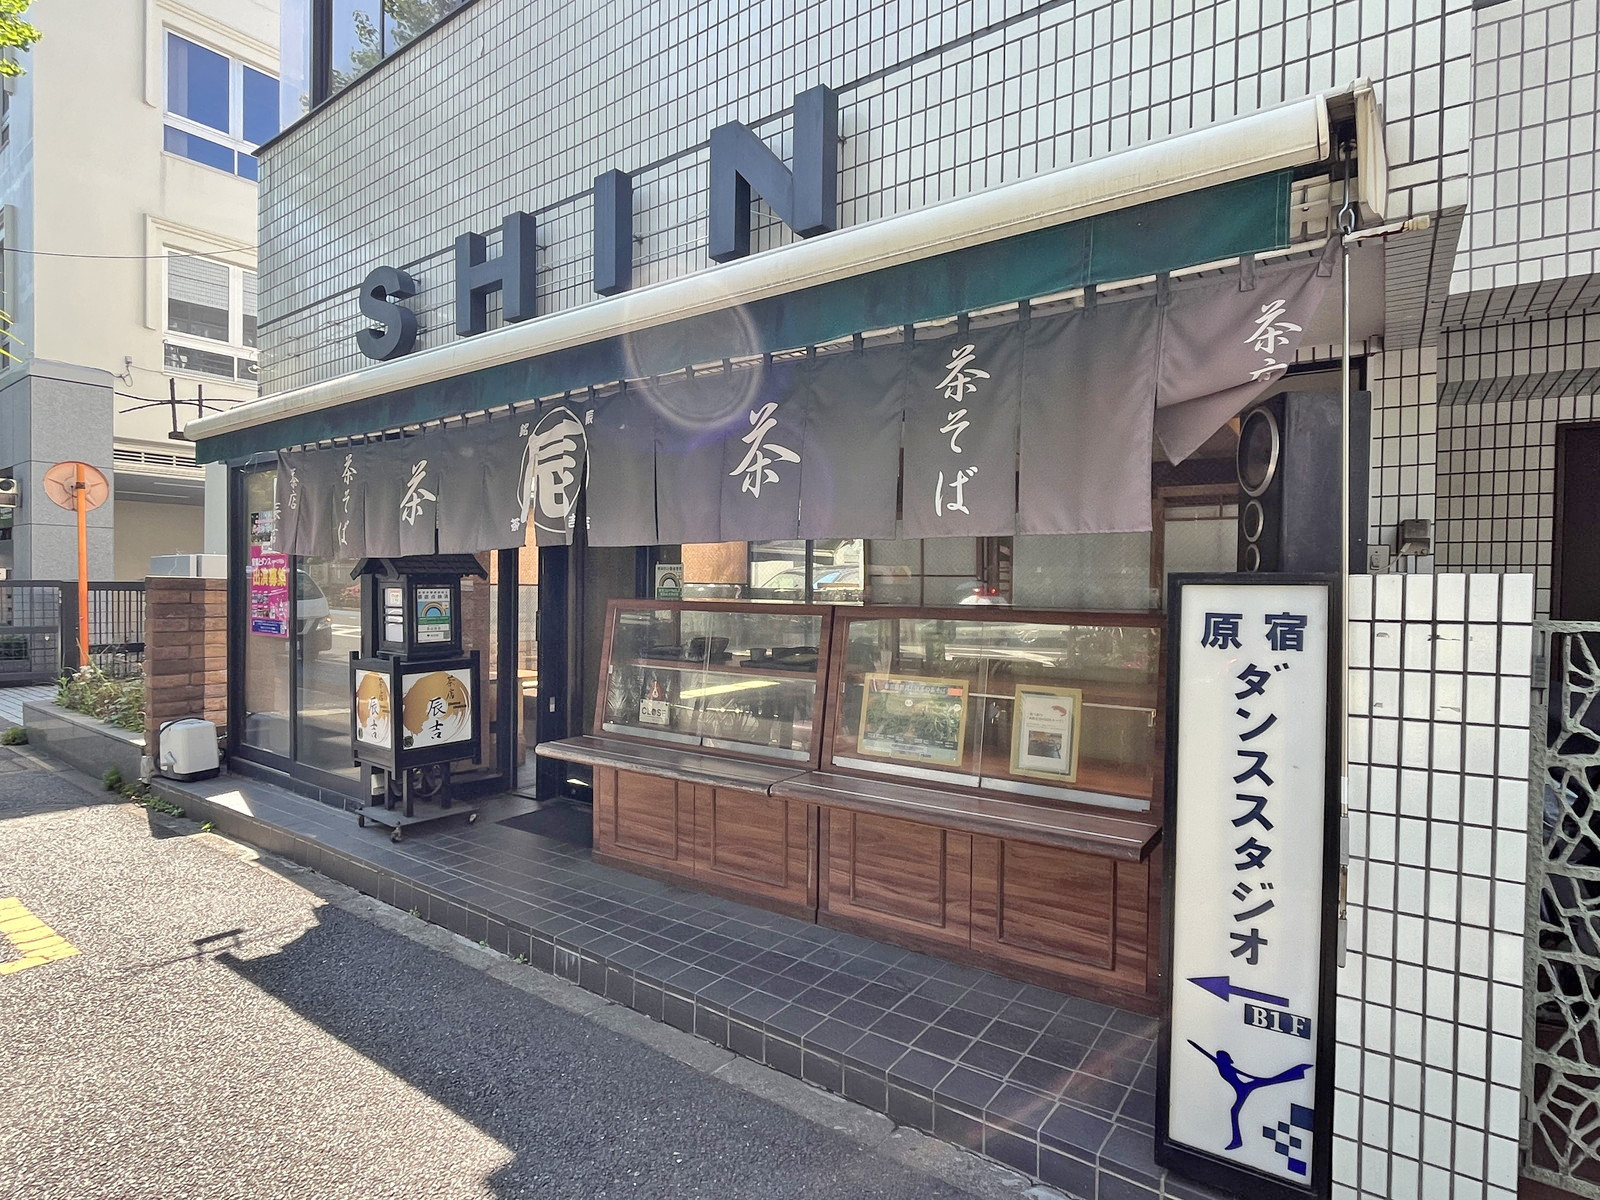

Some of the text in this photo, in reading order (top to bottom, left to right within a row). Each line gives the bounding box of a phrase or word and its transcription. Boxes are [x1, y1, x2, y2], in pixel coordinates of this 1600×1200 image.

[356, 83, 839, 361] SHIN
[729, 402, 801, 499] 茶
[934, 344, 991, 517] 茶そば
[287, 468, 299, 510] 茶店
[337, 453, 358, 546] 茶そば
[399, 459, 437, 526] 茶
[1201, 611, 1309, 652] 原宿
[445, 674, 456, 701] 茶店
[641, 705, 667, 718] CLOSE
[369, 697, 379, 740] 辰吉
[427, 697, 447, 740] 辰吉
[1230, 662, 1290, 966] ダンススタジオ
